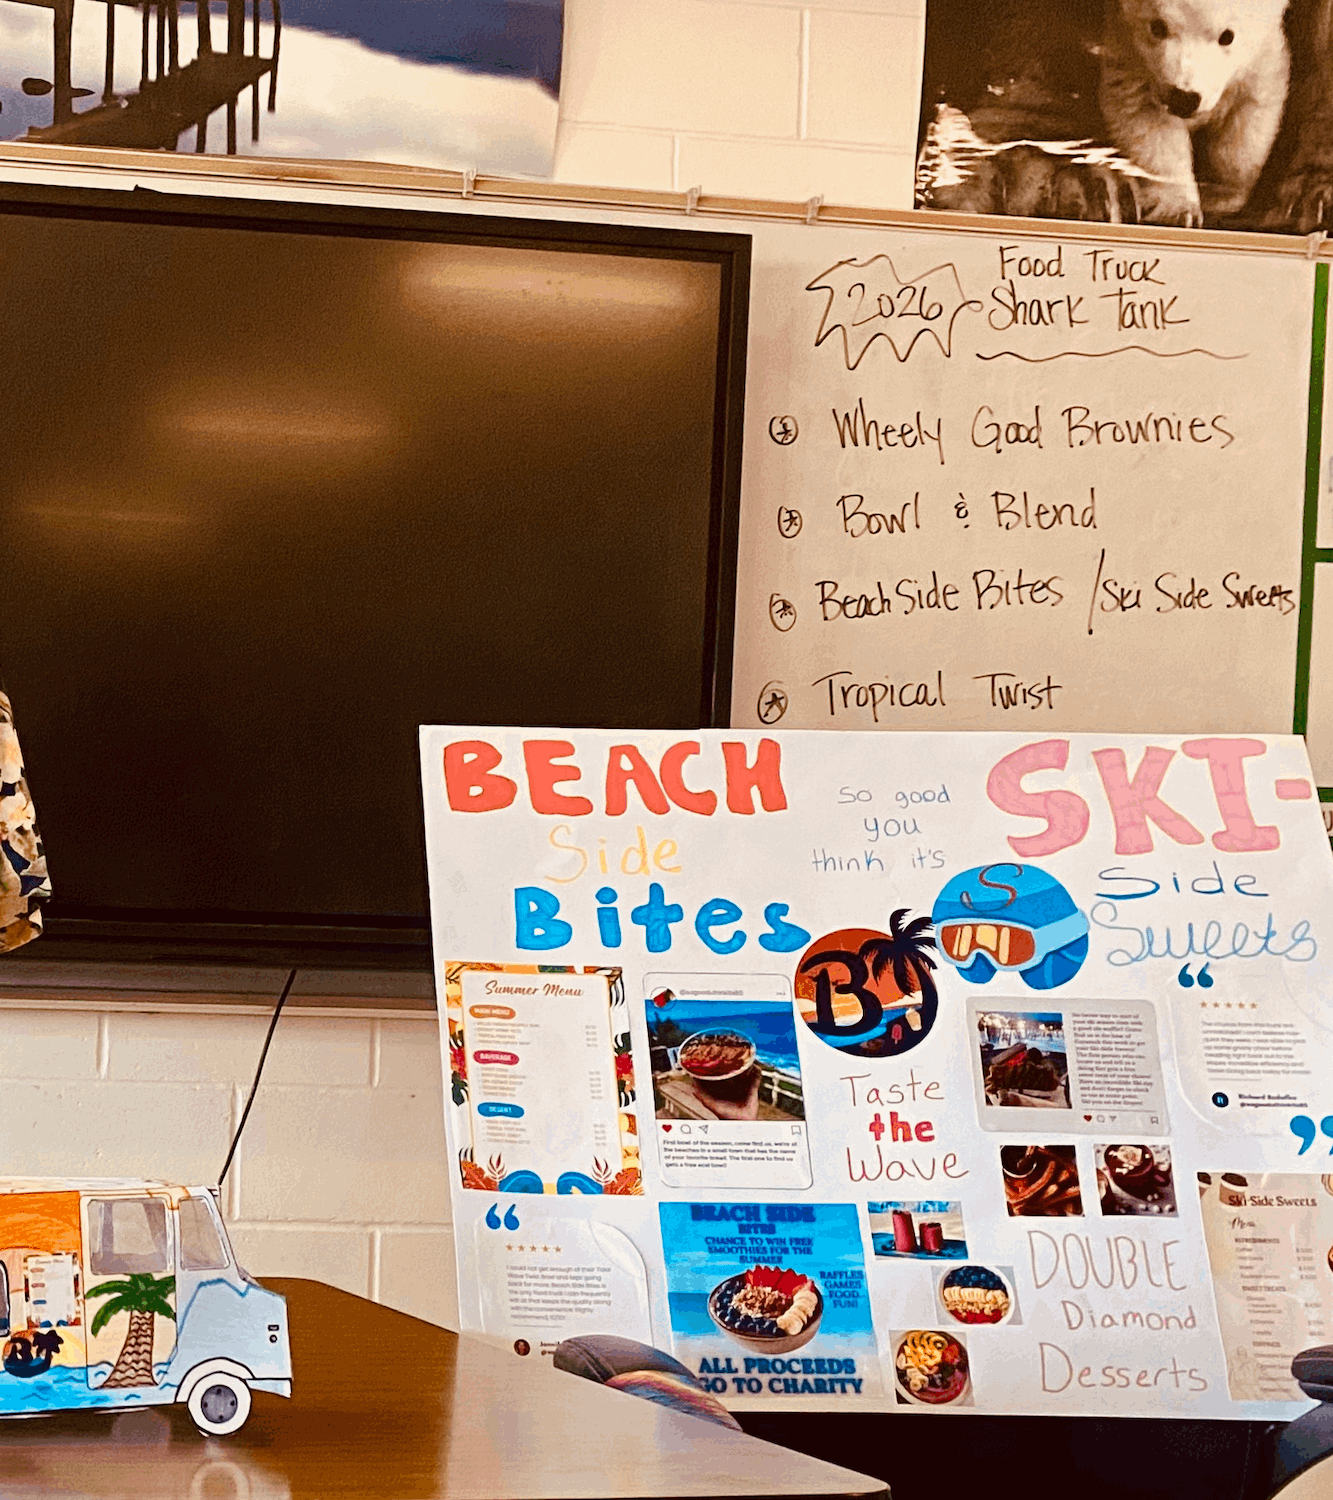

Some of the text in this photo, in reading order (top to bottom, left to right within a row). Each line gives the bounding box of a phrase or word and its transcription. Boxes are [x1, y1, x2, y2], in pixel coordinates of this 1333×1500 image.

[999, 246, 1167, 285] Food Truck
[848, 285, 943, 326] 2026
[988, 286, 1190, 330] Shark Tank
[832, 397, 1235, 465] Wheely Good Brownies
[837, 492, 920, 538] Bowl
[991, 487, 1098, 530] Blend
[815, 581, 891, 621] Beach
[896, 570, 959, 615] Side
[973, 569, 1063, 610] Bites
[1155, 572, 1213, 613] Side
[812, 670, 1063, 723] Tropical Twist
[443, 738, 788, 817] BEACH
[838, 785, 951, 810] So good
[864, 816, 920, 842] you
[544, 823, 683, 884] Side
[812, 847, 946, 873] think it's
[1093, 861, 1270, 900] Side
[514, 883, 811, 955] Bites
[1090, 901, 1318, 967] Sweets
[485, 979, 584, 998] Summer Menu
[840, 1069, 945, 1106] Taste
[869, 1111, 935, 1143] the
[847, 1144, 969, 1182] Wave
[691, 1205, 816, 1222] BEACH SIDE
[1276, 1196, 1317, 1207] Sweets
[705, 1236, 813, 1246] CHANCE TO WIN FREE
[770, 1246, 789, 1254] FOR
[792, 1247, 813, 1255] THE
[819, 1270, 863, 1279] RAFFLES
[1027, 1230, 1187, 1291] DOUBLE
[824, 1281, 861, 1289] GAMES
[1061, 1300, 1197, 1331] Diamond
[699, 1358, 856, 1374] ALL PROCEEDS
[1039, 1342, 1208, 1393] Desserts
[699, 1378, 863, 1394] GO TO CHARITY
